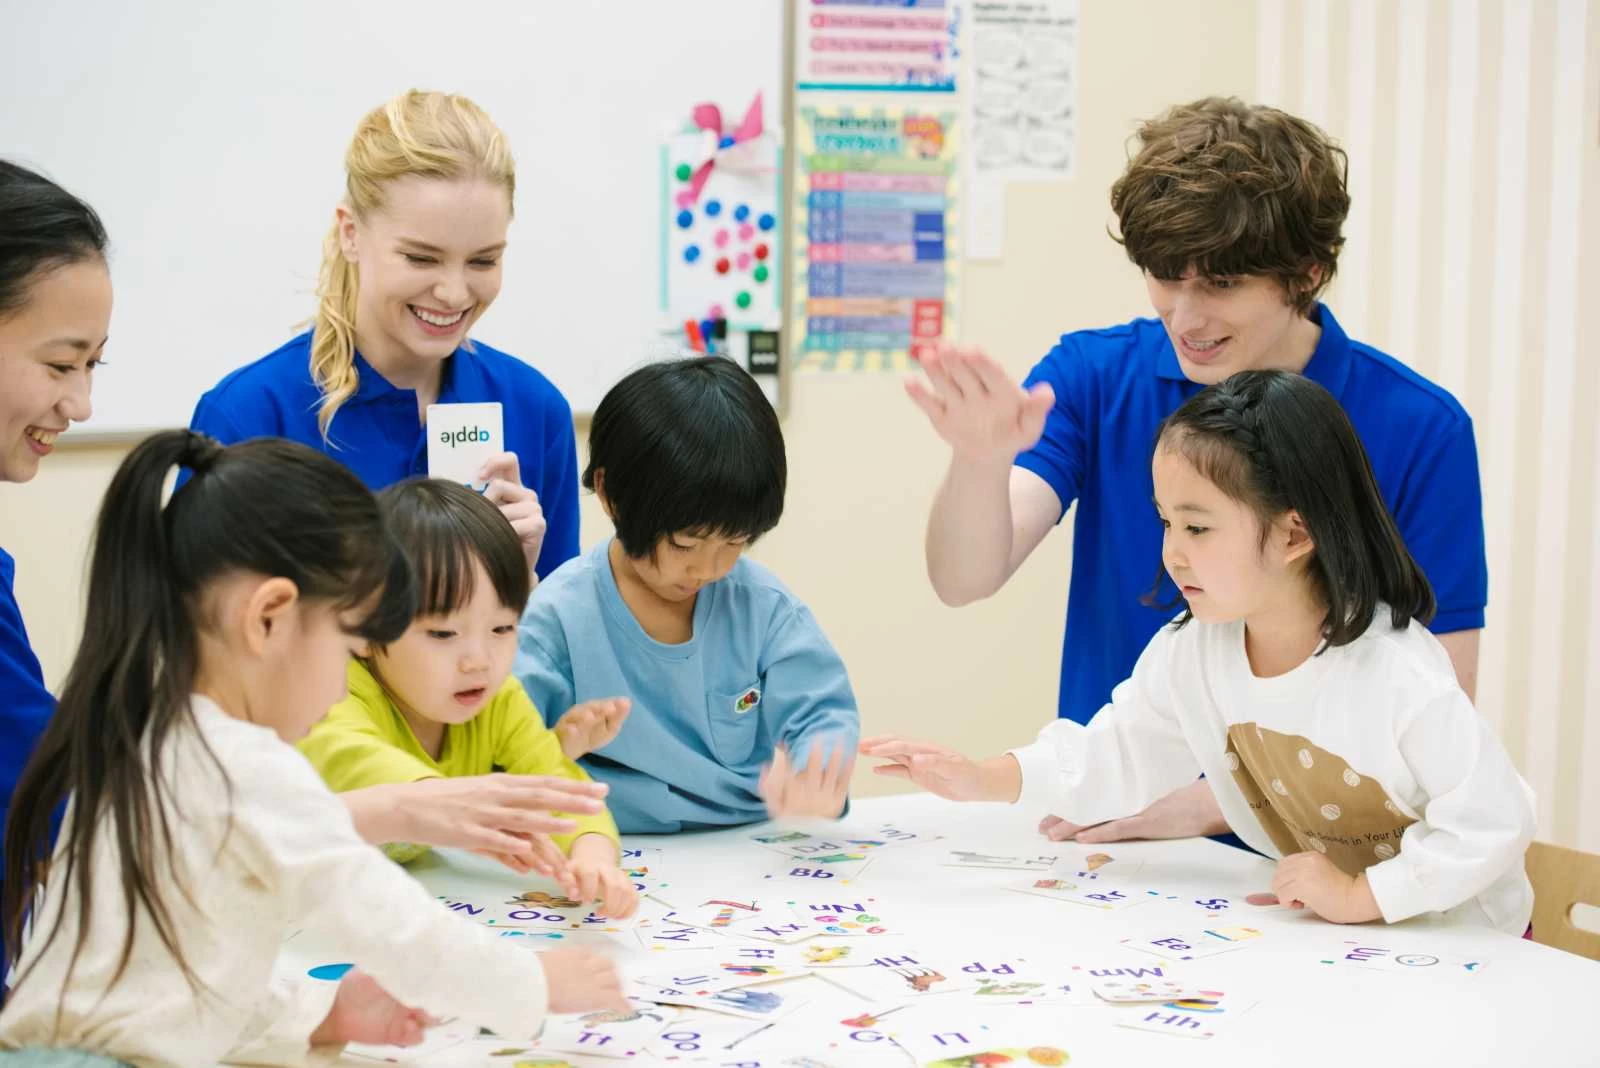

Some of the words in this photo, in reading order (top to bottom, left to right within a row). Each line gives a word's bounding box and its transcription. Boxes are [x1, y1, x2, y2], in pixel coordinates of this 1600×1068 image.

[440, 426, 490, 448] apple
[1364, 832, 1390, 841] Your
[789, 868, 834, 879] Bb
[1085, 890, 1127, 901] Rr
[809, 903, 866, 913] Nn
[1195, 898, 1229, 910] Ss
[508, 910, 566, 921] Oo
[653, 928, 698, 941] Yy
[754, 923, 808, 936] Xx
[1150, 937, 1191, 950] Ee
[1089, 967, 1164, 978] Mm
[1143, 1012, 1201, 1028] Hh
[578, 1032, 612, 1045] Tt
[661, 1032, 701, 1051] Oo
